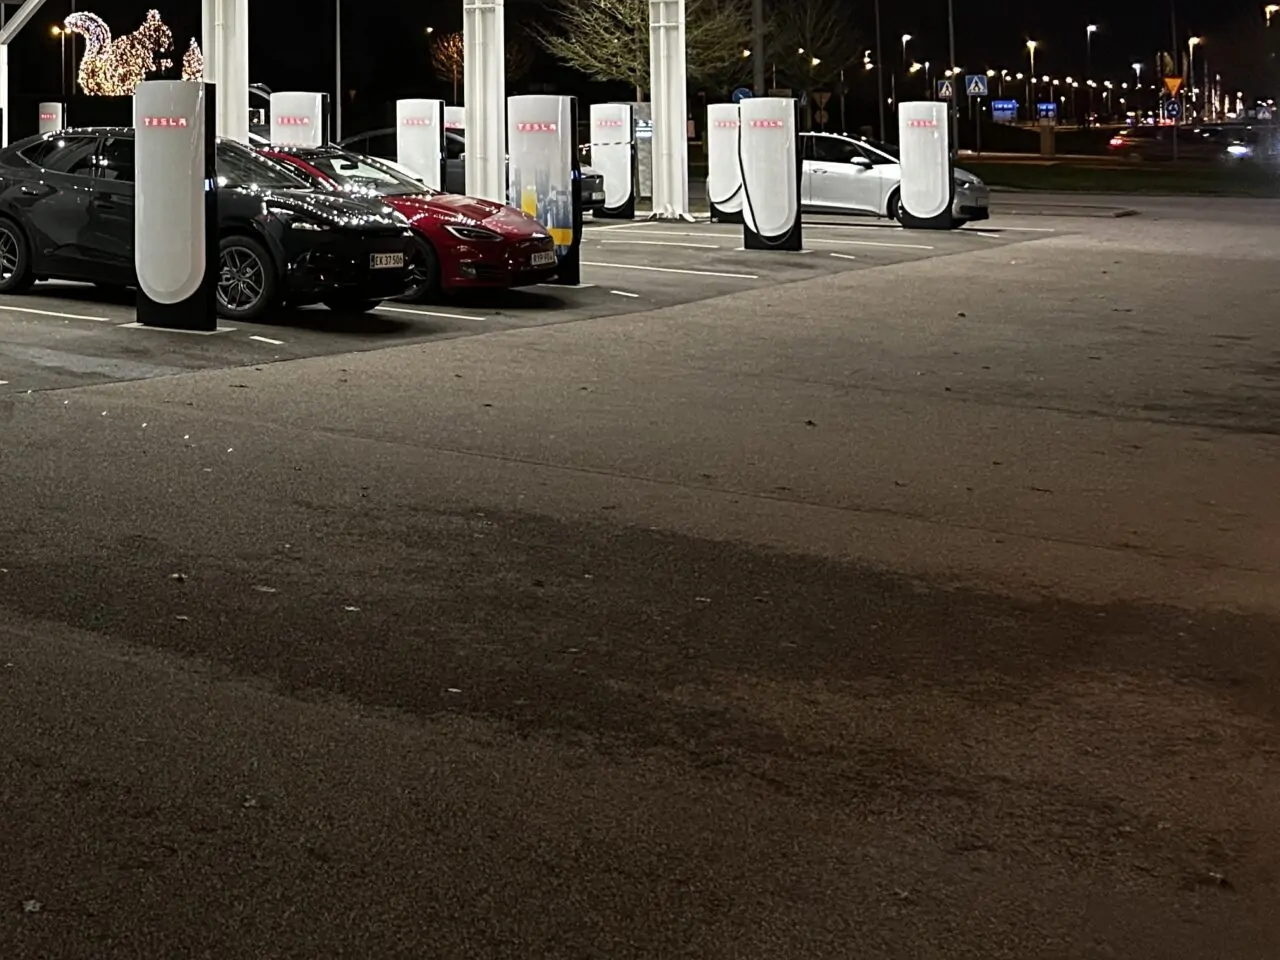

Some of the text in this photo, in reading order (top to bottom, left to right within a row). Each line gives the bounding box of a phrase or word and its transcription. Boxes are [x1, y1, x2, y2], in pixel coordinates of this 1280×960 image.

[144, 117, 187, 127] TESLA
[749, 120, 783, 128] TESLA
[517, 123, 557, 131] TESLA
[384, 255, 392, 265] 37
